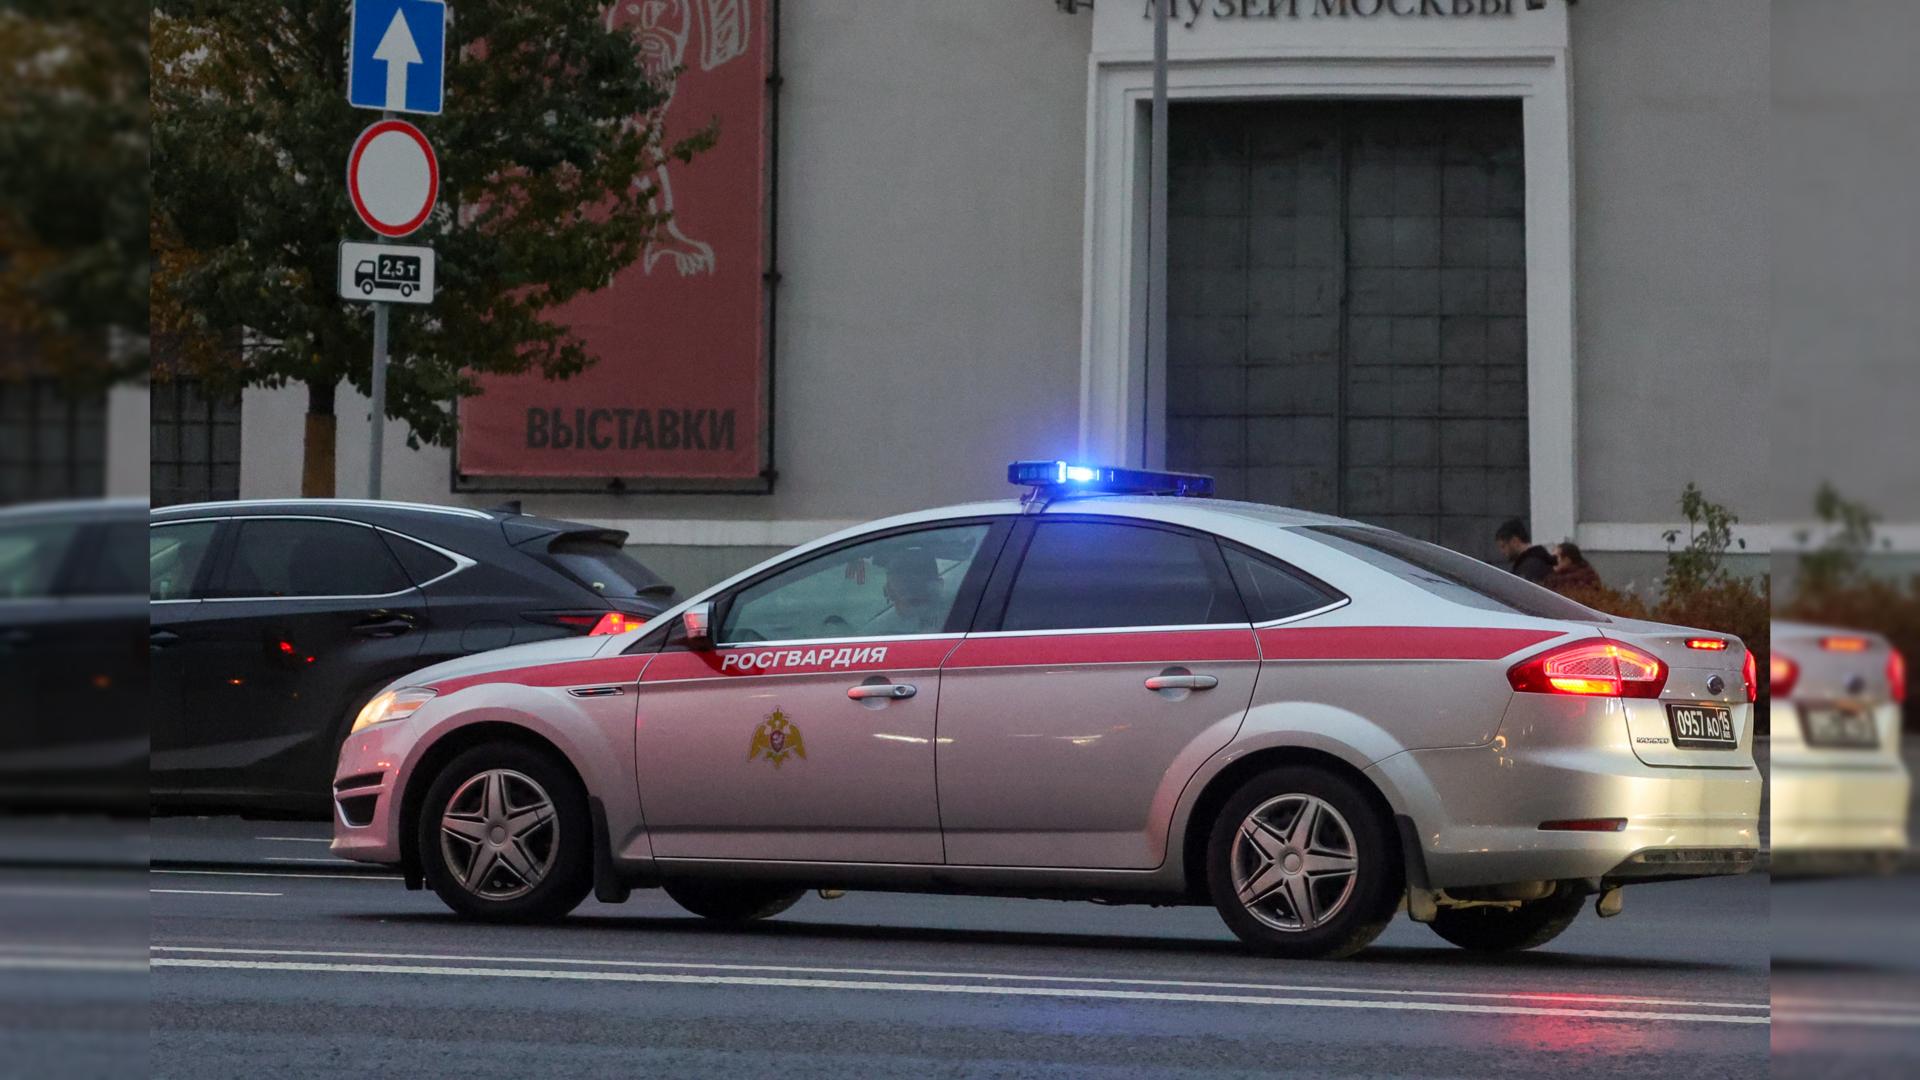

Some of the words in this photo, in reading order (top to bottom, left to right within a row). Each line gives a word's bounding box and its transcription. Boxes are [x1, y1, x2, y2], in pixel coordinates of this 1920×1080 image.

[382, 259, 405, 277] 2,5
[526, 407, 737, 450] ВЫСТАВКИ
[721, 646, 888, 671] РОСГВАРДИЯ
[1677, 709, 1705, 736] 0957
